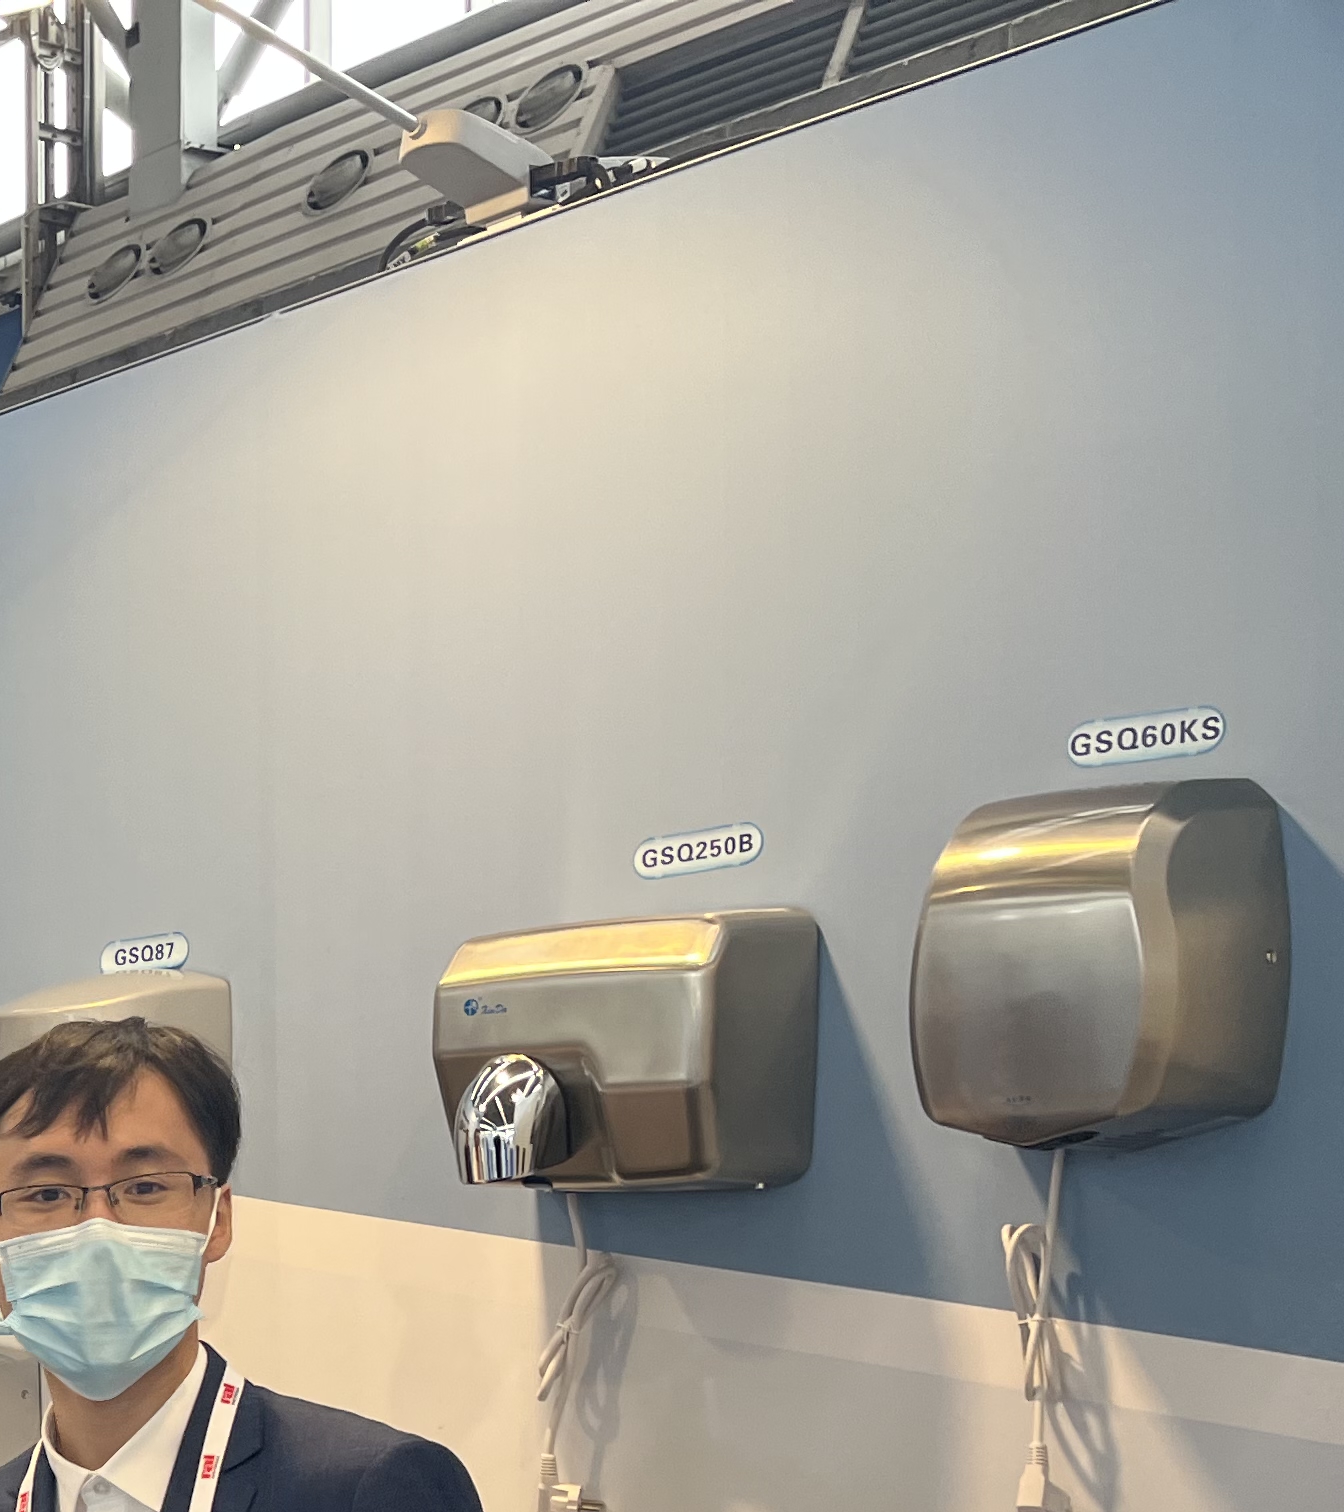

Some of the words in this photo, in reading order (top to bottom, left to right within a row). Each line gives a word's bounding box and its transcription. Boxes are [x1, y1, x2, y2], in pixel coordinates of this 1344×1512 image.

[1068, 715, 1223, 759] GSQ60KS
[640, 832, 756, 871] GSQ250B
[113, 941, 176, 967] GSQ87
